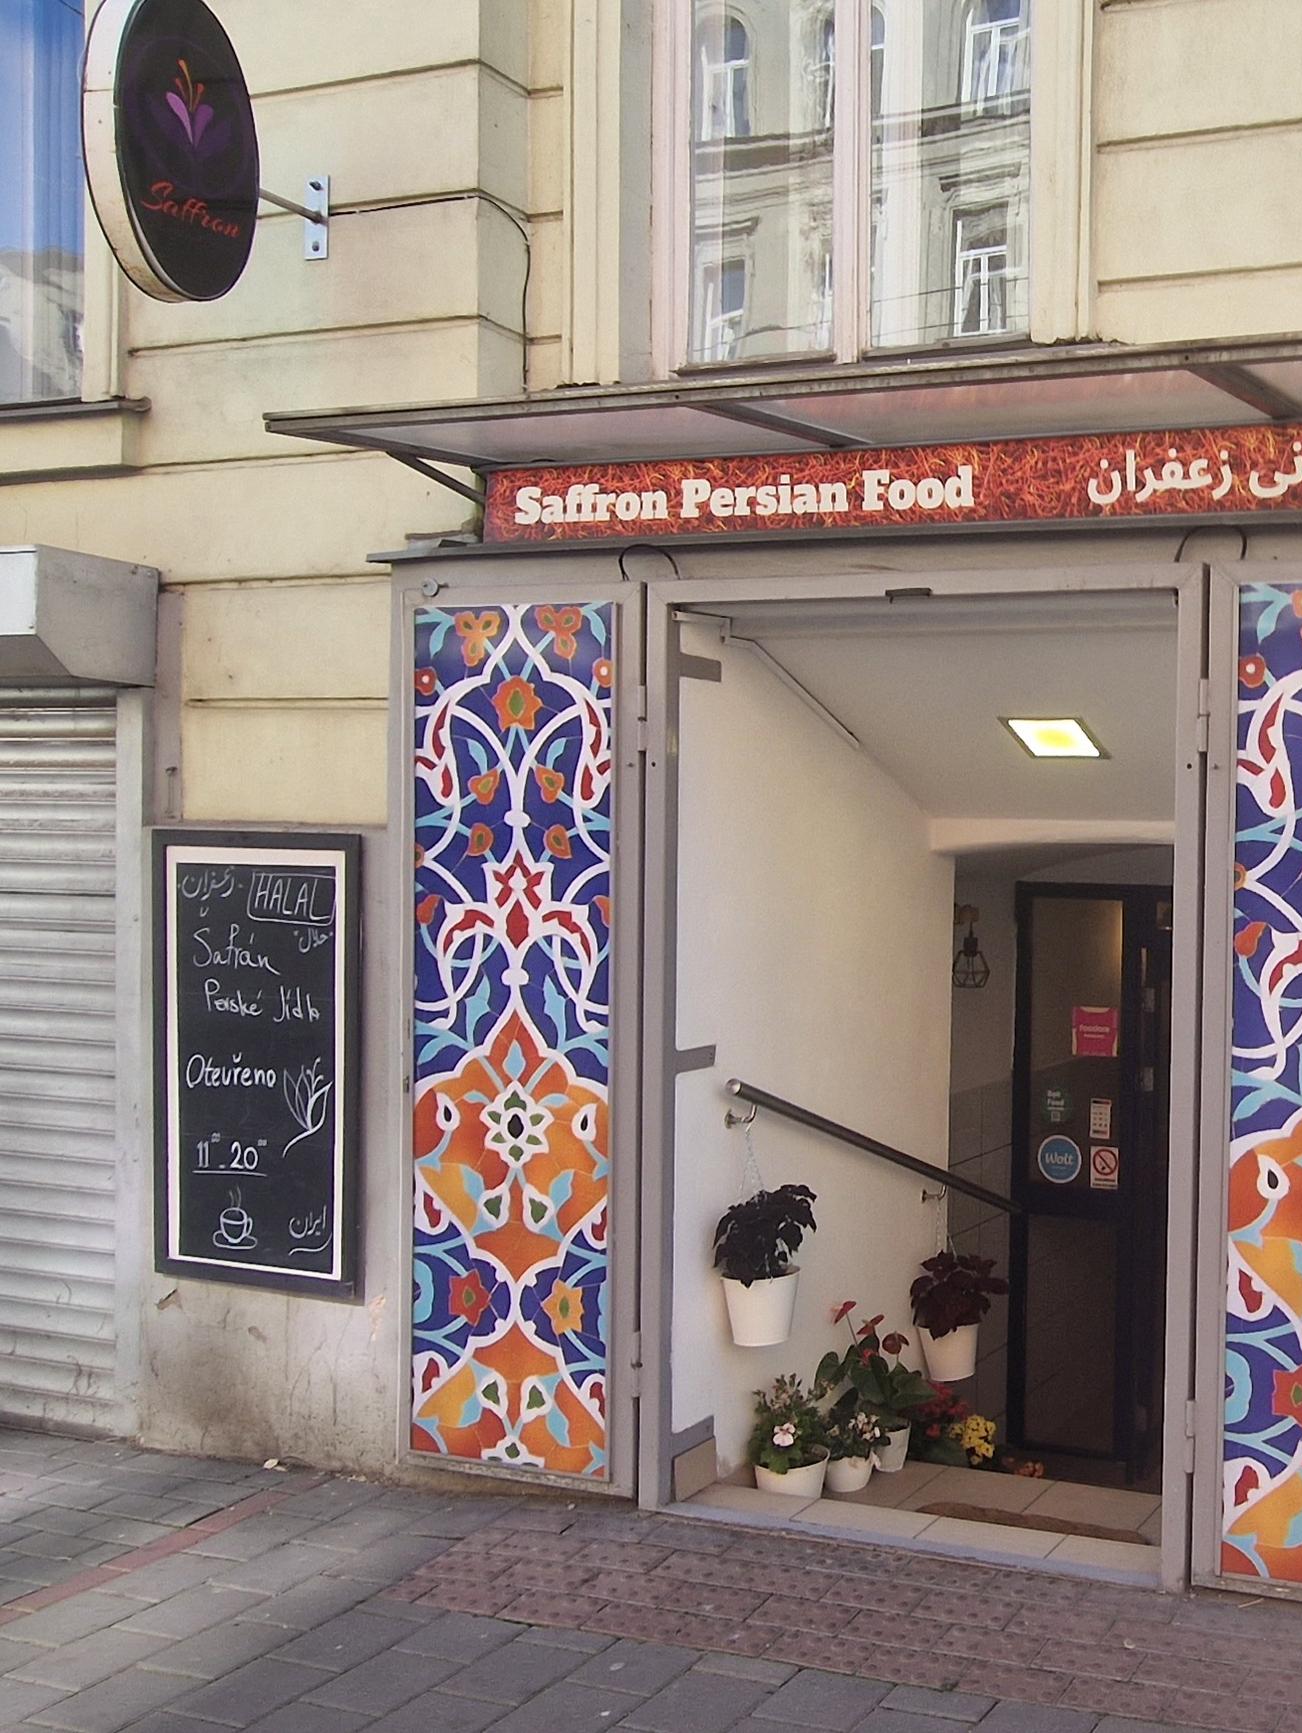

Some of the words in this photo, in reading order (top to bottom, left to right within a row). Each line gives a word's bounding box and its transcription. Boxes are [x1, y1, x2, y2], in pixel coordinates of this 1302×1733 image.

[141, 181, 240, 238] Saffron
[514, 484, 668, 525] Saffron
[680, 474, 849, 519] Persian
[861, 465, 975, 512] Food
[1086, 446, 1234, 504] زعفران
[253, 872, 331, 921] HALAL
[185, 1052, 277, 1089] Otevřeno
[1045, 1152, 1074, 1165] Wolt
